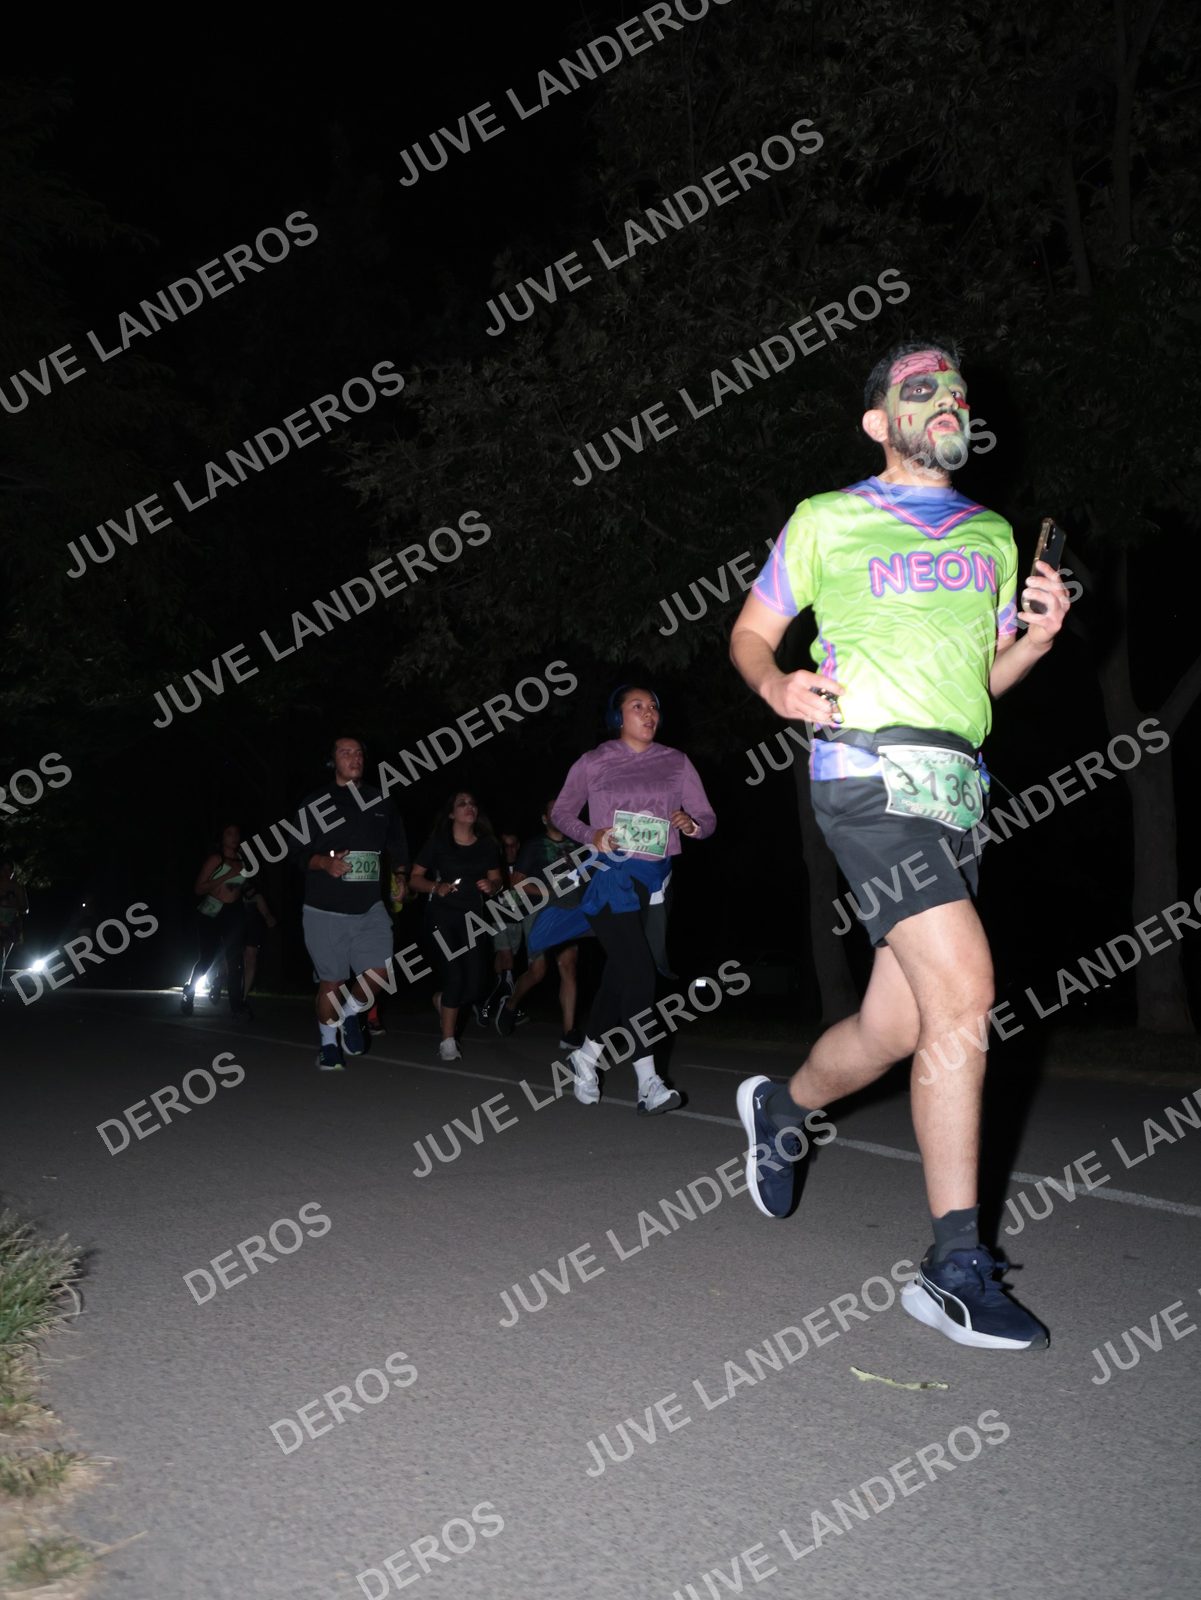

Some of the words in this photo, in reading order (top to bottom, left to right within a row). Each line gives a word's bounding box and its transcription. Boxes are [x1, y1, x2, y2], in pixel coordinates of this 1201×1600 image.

[869, 546, 997, 598] NEÓN
[897, 771, 976, 811] 3136
[347, 860, 377, 873] 202
